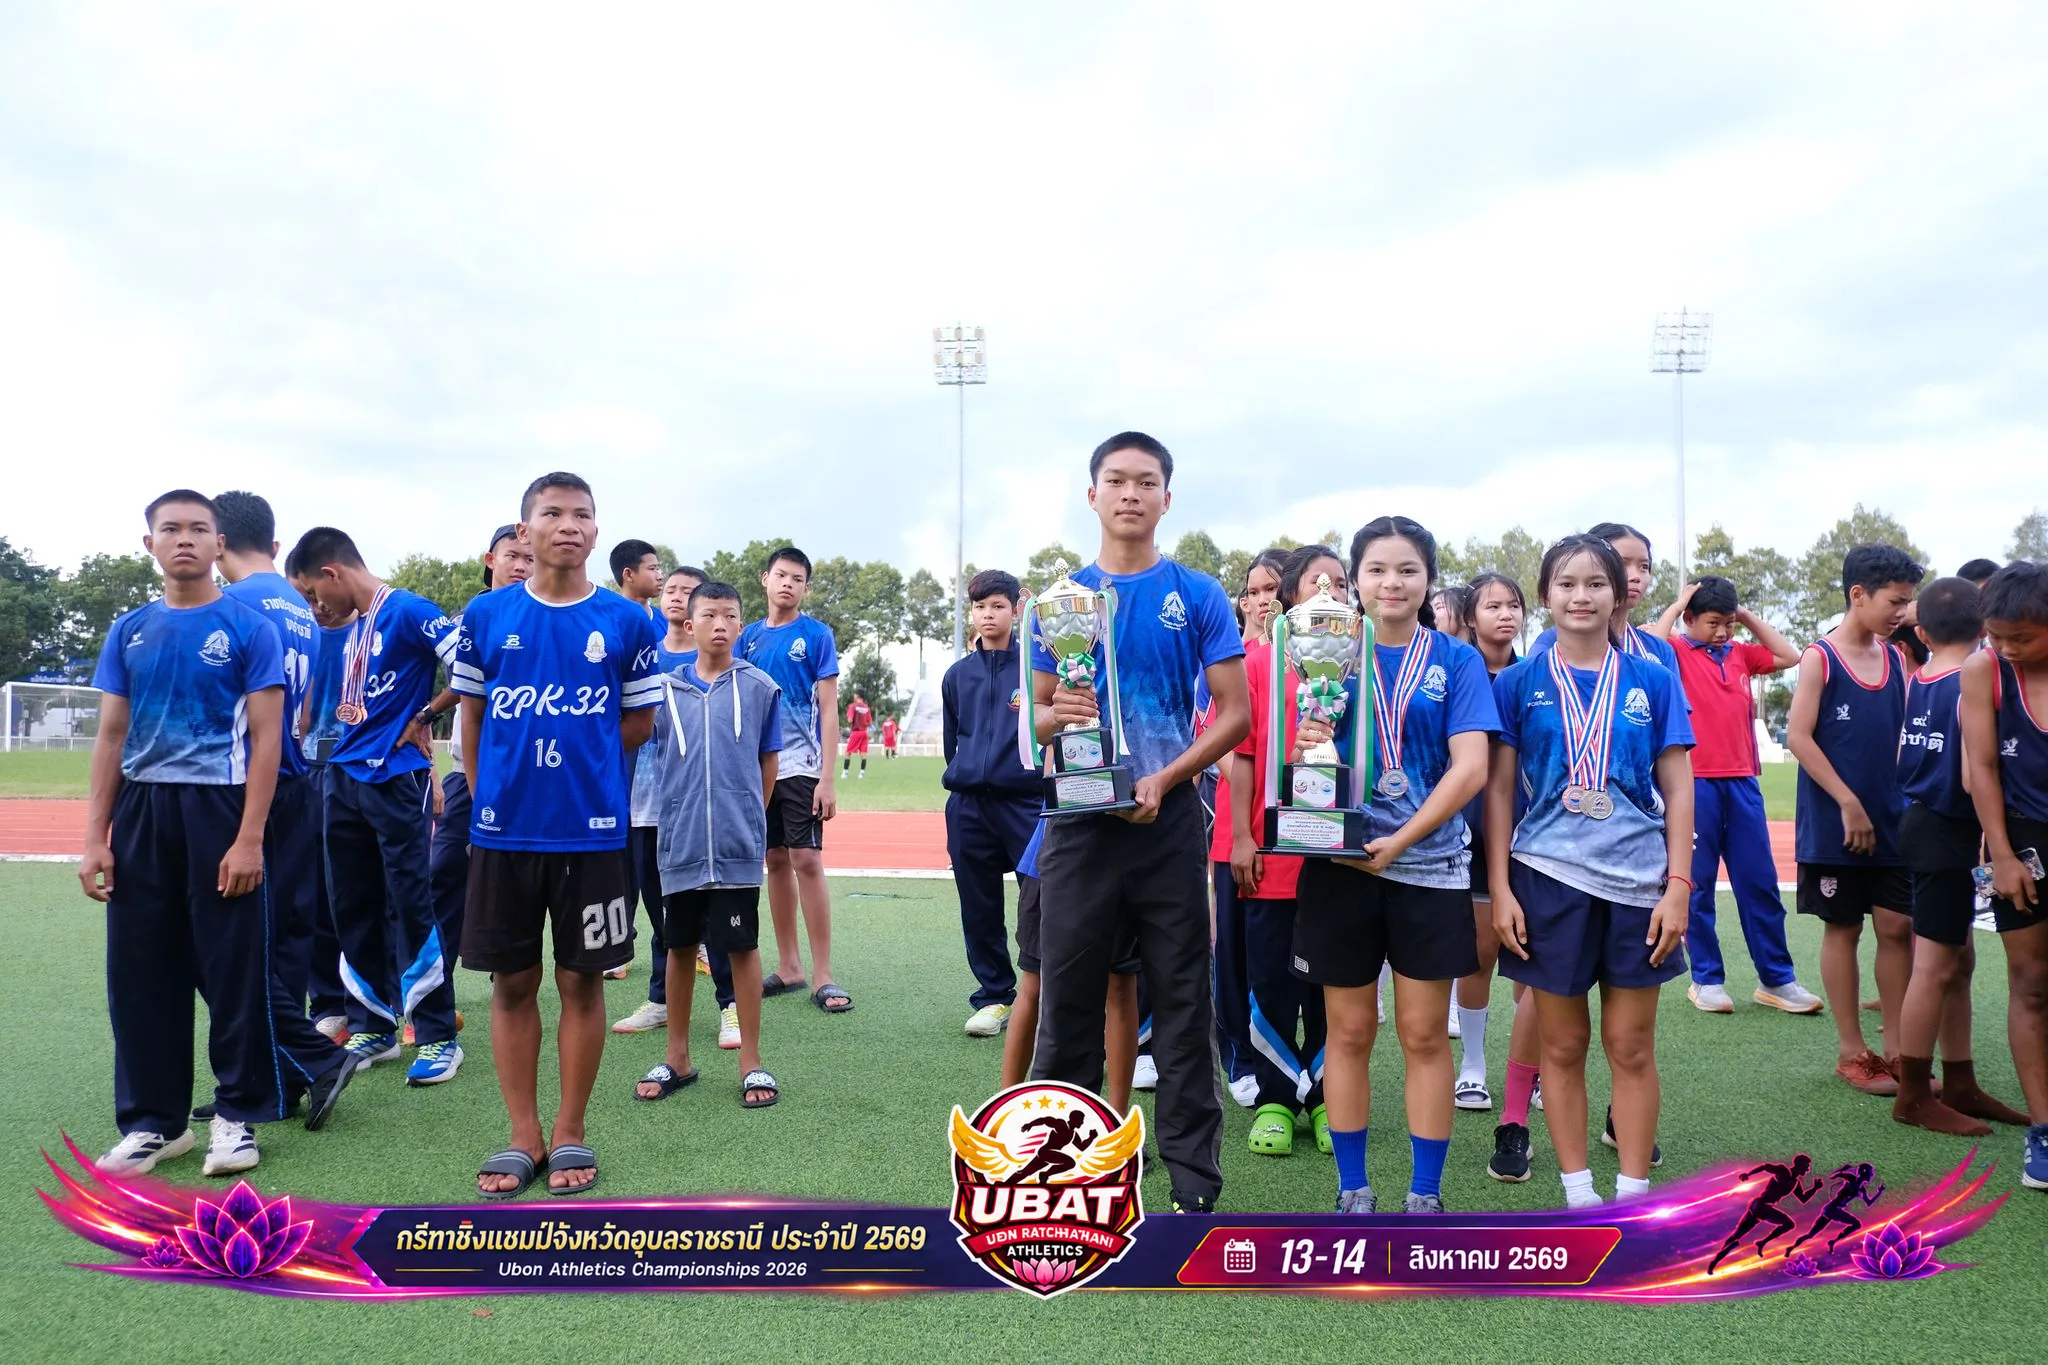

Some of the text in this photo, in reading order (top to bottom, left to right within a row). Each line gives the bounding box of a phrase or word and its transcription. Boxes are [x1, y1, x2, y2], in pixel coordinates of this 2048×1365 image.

[491, 684, 610, 719] RPK.32
[534, 738, 562, 768] 16
[582, 896, 628, 950] 20
